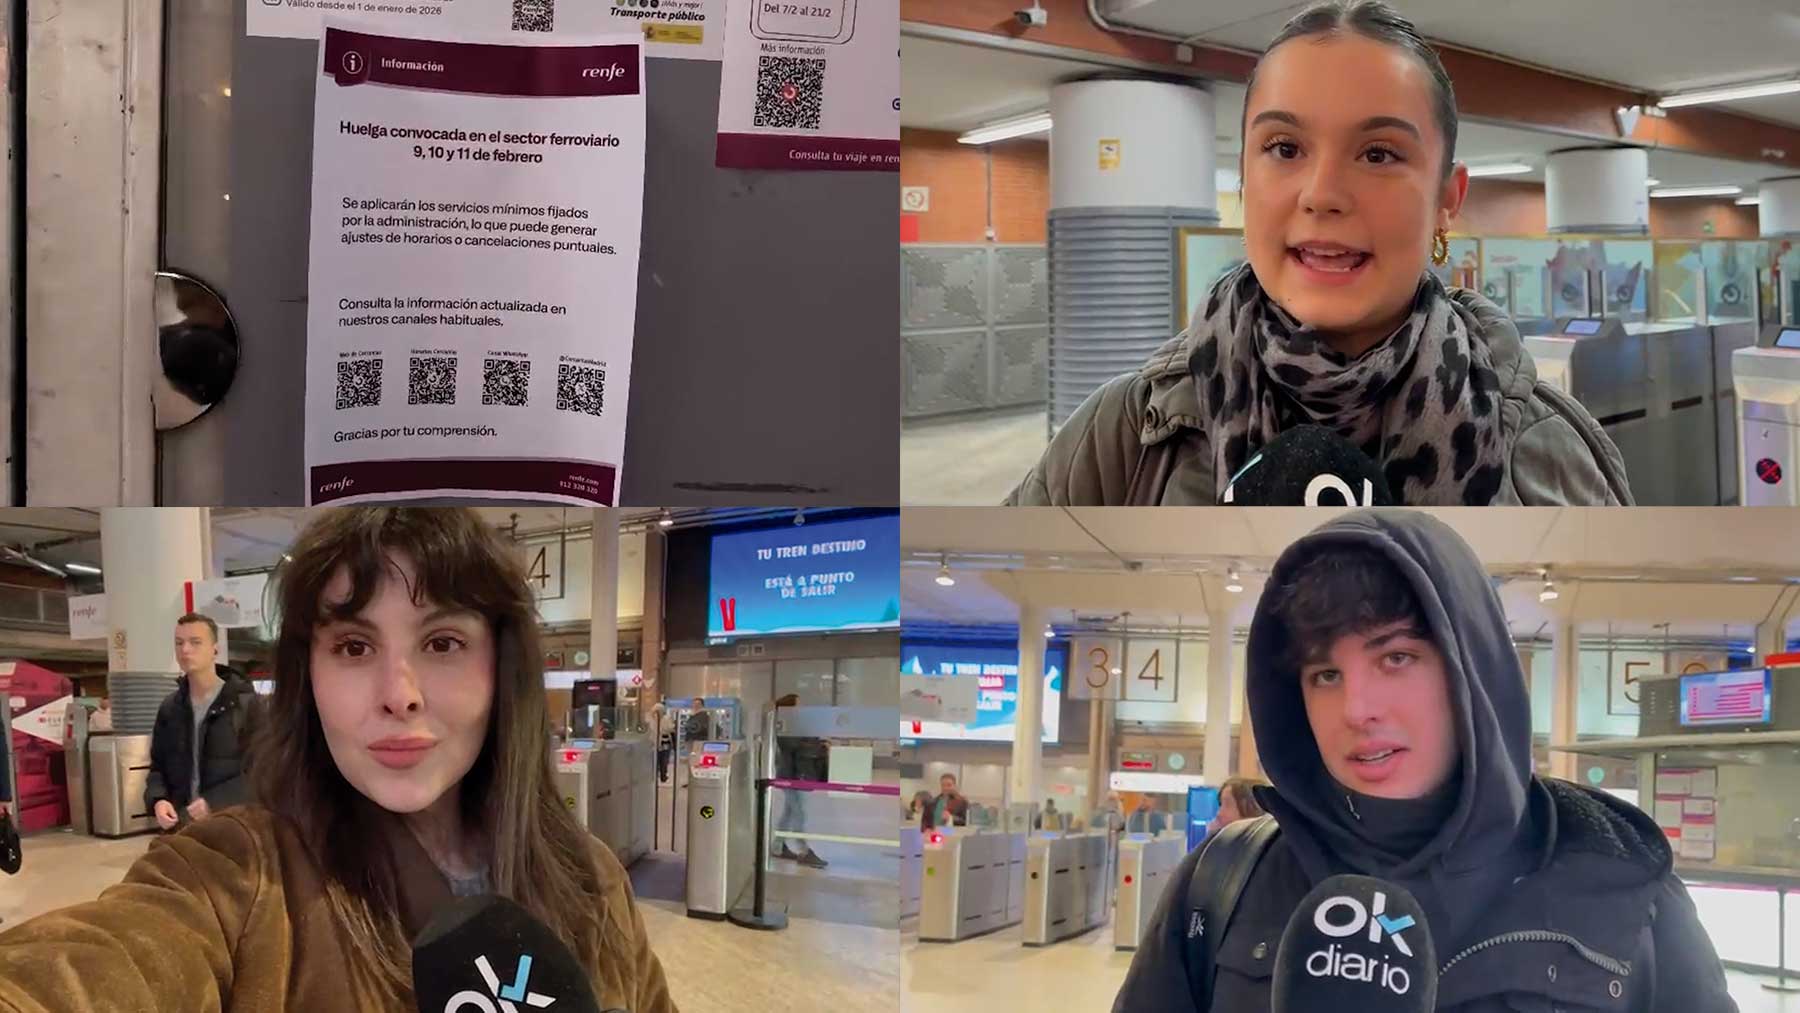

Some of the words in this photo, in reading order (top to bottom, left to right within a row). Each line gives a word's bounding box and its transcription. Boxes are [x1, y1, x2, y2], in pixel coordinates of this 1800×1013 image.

[316, 1, 345, 10] desde
[347, 2, 356, 10] el
[357, 3, 362, 11] 1
[364, 3, 376, 12] de
[379, 5, 403, 13] enero
[405, 5, 418, 14] de
[418, 6, 442, 15] 2026
[610, 7, 667, 20] Transporte
[668, 10, 705, 22] público
[764, 3, 780, 14] Del
[783, 4, 798, 15] 7/2
[799, 6, 809, 16] al
[811, 7, 832, 18] 21/2
[760, 43, 776, 53] Más
[778, 44, 825, 55] información
[381, 57, 444, 73] Información
[582, 62, 625, 82] renfe
[340, 120, 388, 139] Huelga
[390, 127, 466, 141] convocada
[469, 131, 487, 142] en
[488, 130, 501, 143] el
[503, 132, 547, 145] sector
[549, 132, 620, 148] ferroviario
[413, 145, 426, 159] 9,
[428, 146, 445, 159] 10
[446, 149, 455, 162] y
[457, 147, 470, 160] 11
[472, 148, 490, 161] de
[492, 148, 543, 164] febrero
[789, 149, 830, 161] Consulta
[832, 151, 843, 161] tu
[845, 152, 868, 164] viaje
[870, 154, 882, 163] en
[342, 197, 359, 209] Se
[360, 198, 416, 212] aplicarán
[418, 200, 436, 212] los
[437, 202, 490, 214] servicios
[492, 203, 545, 216] mínimos
[547, 205, 589, 220] fijados
[342, 216, 362, 228] por
[364, 215, 375, 226] la
[376, 215, 470, 231] administración,
[471, 218, 482, 230] lo
[483, 221, 507, 232] que
[509, 221, 549, 233] puede
[550, 223, 598, 237] generar
[341, 231, 384, 245] ajustes
[385, 232, 402, 244] de
[403, 232, 453, 245] horarios
[454, 236, 463, 245] o
[464, 235, 551, 249] cancelaciones
[553, 240, 617, 255] puntuales.
[338, 297, 392, 310] Consulta
[394, 297, 405, 309] la
[406, 296, 478, 310] información
[479, 299, 548, 314] actualizada
[550, 304, 567, 315] en
[338, 314, 390, 327] nuestros
[391, 313, 438, 325] canales
[439, 313, 504, 328] habituales.
[334, 430, 378, 443] Gracias
[380, 427, 401, 439] por
[403, 426, 415, 437] tu
[416, 425, 498, 440] comprensión.
[319, 476, 355, 493] renfe
[757, 549, 772, 560] TU
[776, 545, 808, 558] TREN
[812, 539, 866, 555] DESTINO
[527, 546, 551, 589] 4
[810, 571, 855, 585] PUNTO
[781, 587, 796, 599] DE
[801, 584, 836, 597] SALIR
[1086, 647, 1109, 689] 3
[1138, 649, 1164, 691] 4
[1306, 943, 1410, 995] diario
